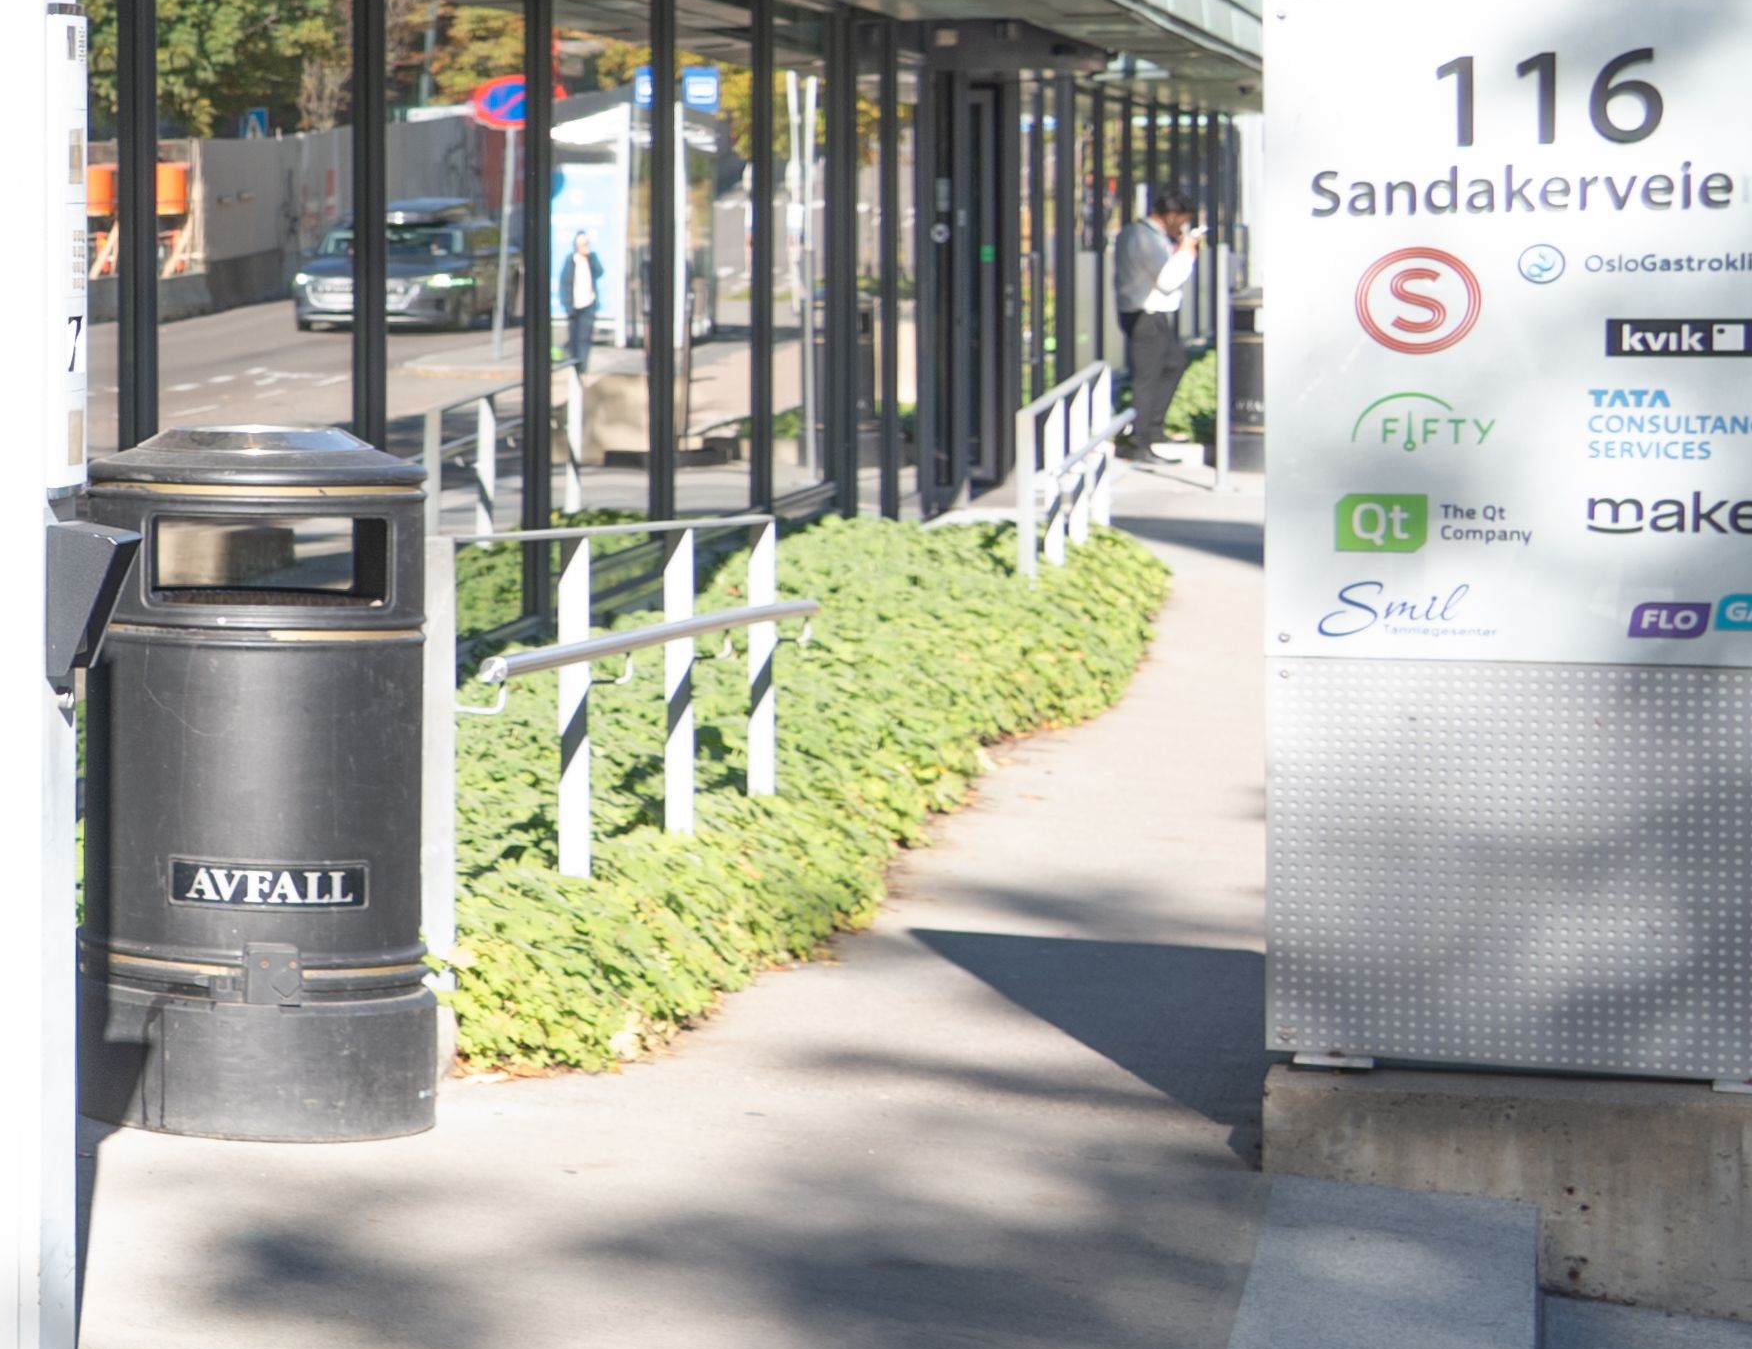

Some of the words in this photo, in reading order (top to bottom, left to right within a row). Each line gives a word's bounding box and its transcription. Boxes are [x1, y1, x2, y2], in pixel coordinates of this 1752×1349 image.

[1435, 47, 1664, 148] 116
[1621, 325, 1703, 352] kvik
[1587, 389, 1671, 408] TATA
[1381, 409, 1496, 452] FIFTY
[1587, 414, 1752, 435] CONSULTAN
[1587, 440, 1712, 460] SERVICES
[1351, 502, 1410, 546] Qt
[1440, 503, 1477, 520] The
[1482, 504, 1506, 522] Qt
[1440, 525, 1533, 546] Company
[1317, 580, 1470, 638] Smil
[1639, 609, 1699, 632] FLO
[1383, 623, 1497, 638] Tannlegesenter
[185, 867, 353, 905] AVFALL
